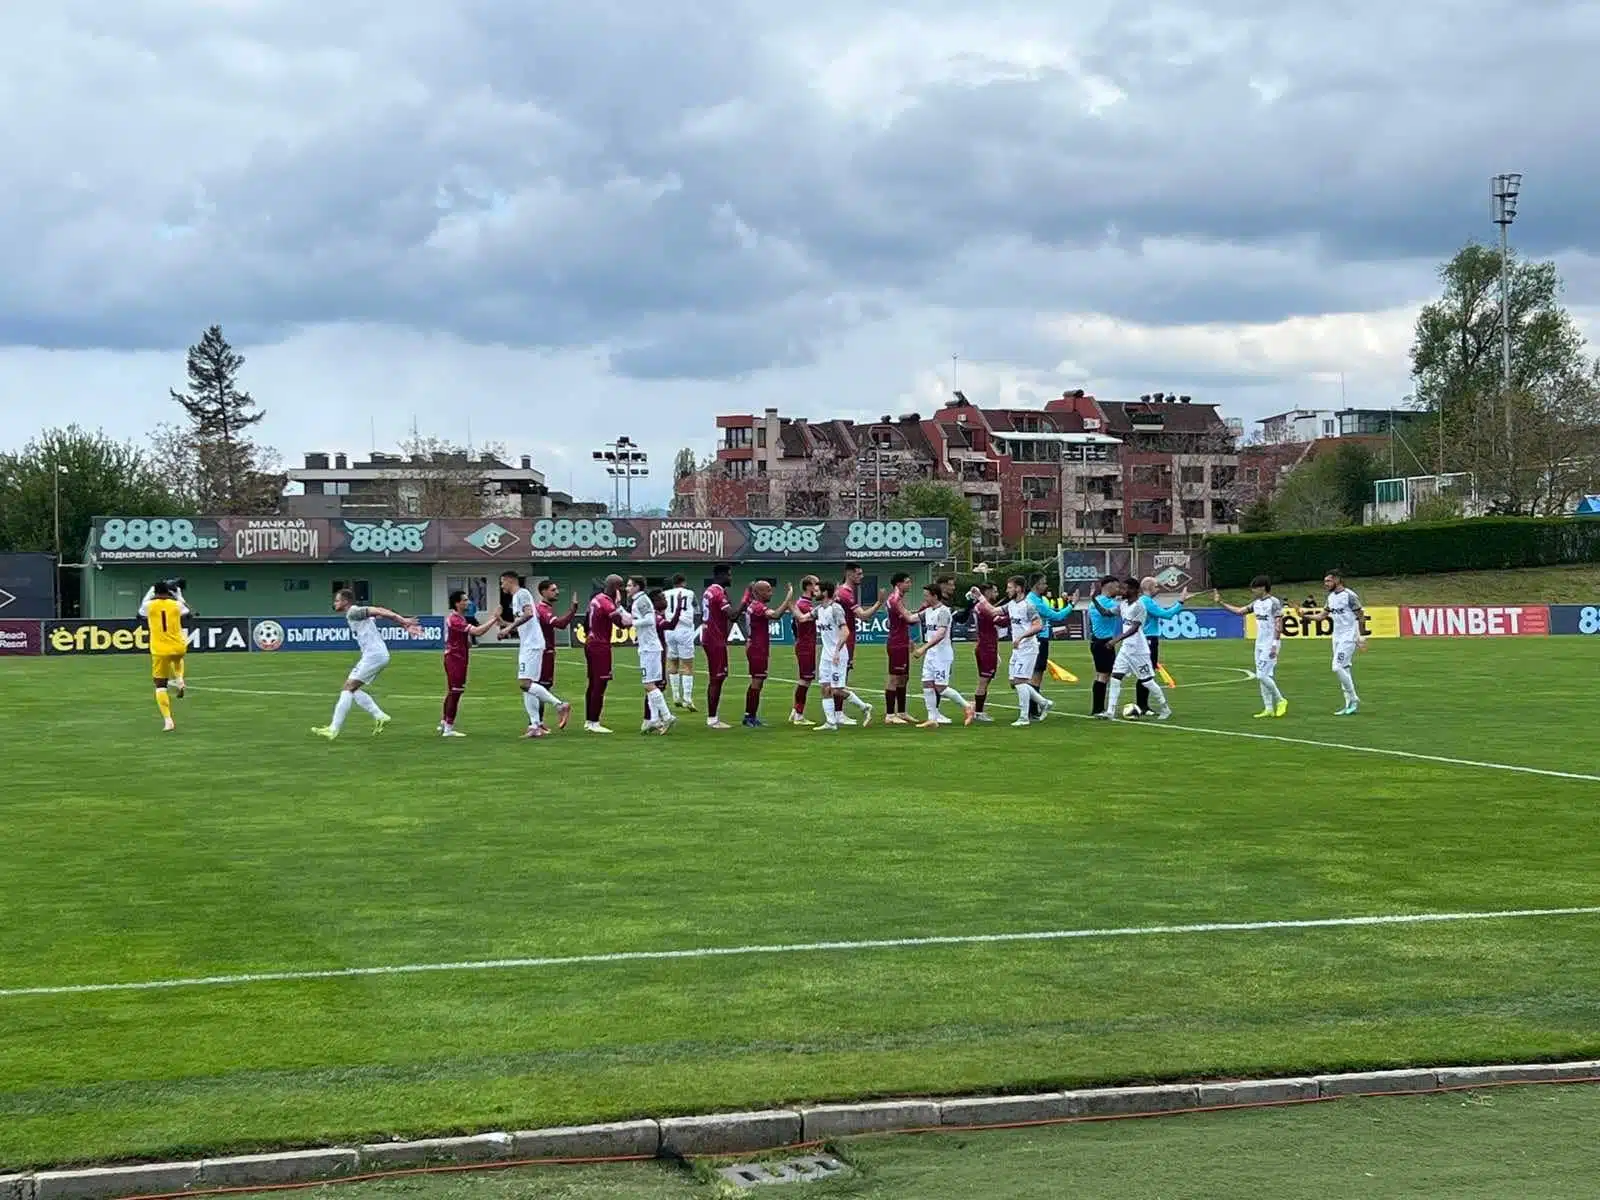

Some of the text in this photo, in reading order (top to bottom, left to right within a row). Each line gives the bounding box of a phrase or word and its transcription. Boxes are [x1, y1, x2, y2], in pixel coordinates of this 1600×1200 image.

[100, 518, 218, 550] 8888.BG
[248, 519, 305, 528] МАЧКАЙ
[531, 519, 636, 549] 8888.BG
[661, 520, 712, 529] МАЧКАЙ
[845, 521, 943, 549] 8888.BG
[236, 528, 318, 559] СЕПТЕМВРИ
[350, 527, 424, 551] 8888
[650, 528, 724, 558] СЕПТЕМВРИ
[753, 528, 819, 551] 8888
[156, 551, 198, 559] СПОРТА
[161, 610, 167, 632] 1
[855, 617, 890, 632] BEAC
[1409, 607, 1523, 634] WINBET
[182, 627, 246, 648] ИГА
[287, 628, 350, 641] БЪЛГАРСКИ
